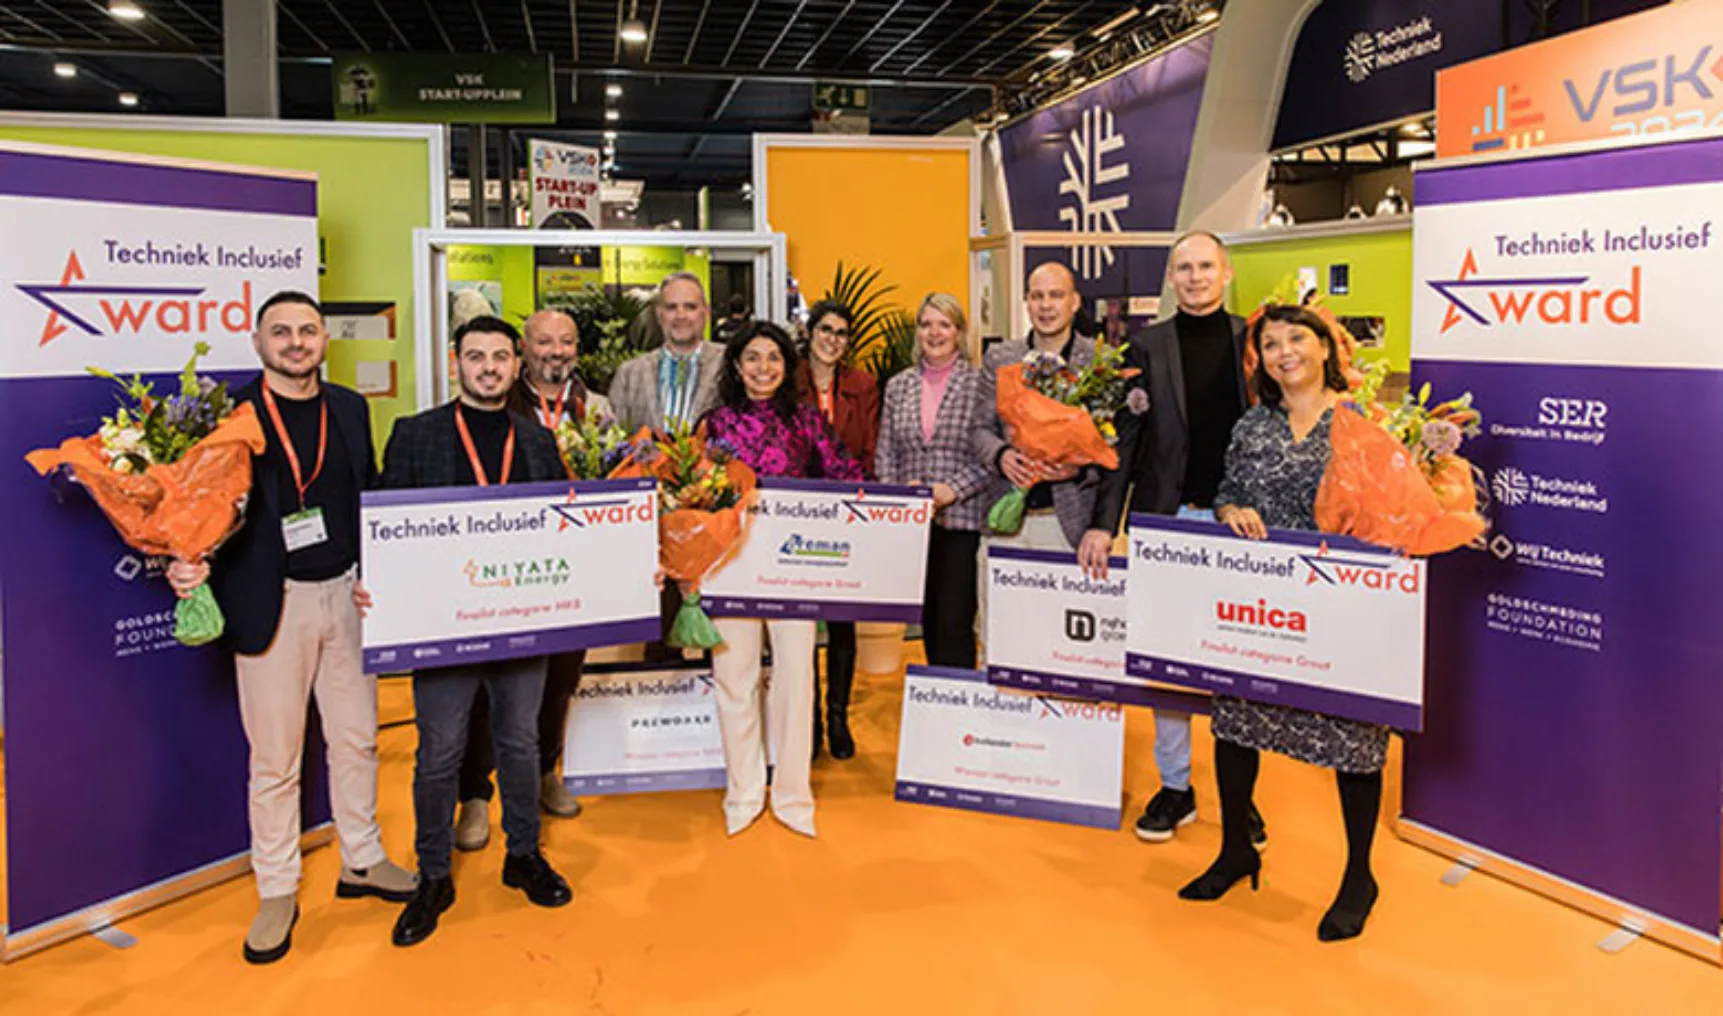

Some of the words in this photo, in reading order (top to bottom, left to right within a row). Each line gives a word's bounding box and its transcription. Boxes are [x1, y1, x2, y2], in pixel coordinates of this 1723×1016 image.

[1375, 15, 1432, 49] Techniek
[1375, 31, 1443, 69] Nederland
[455, 72, 485, 86] VSK
[1563, 45, 1713, 122] VSK
[536, 176, 598, 195] START-UP
[548, 194, 586, 210] PLEIN
[1495, 229, 1595, 257] Techniek
[1604, 221, 1711, 252] Inclusief
[105, 239, 209, 267] Techniek
[217, 245, 303, 269] Inclusief
[1539, 397, 1607, 428] SER
[1530, 474, 1597, 495] Techniek
[776, 501, 839, 520] Inclusief
[1530, 491, 1608, 513] Nederland
[368, 516, 460, 541] Techniek
[468, 509, 547, 532] Inclusief
[483, 559, 569, 578] NIYATA
[1134, 541, 1212, 568] Techniek
[1216, 551, 1295, 577] Inclusief
[515, 574, 569, 586] Energy
[993, 567, 1058, 590] Techniek
[1216, 599, 1307, 632] unica
[1486, 606, 1602, 640] FOUNDATION
[638, 677, 695, 696] Inclusief
[908, 686, 970, 707] Techniek
[973, 694, 1032, 713] Inclusief
